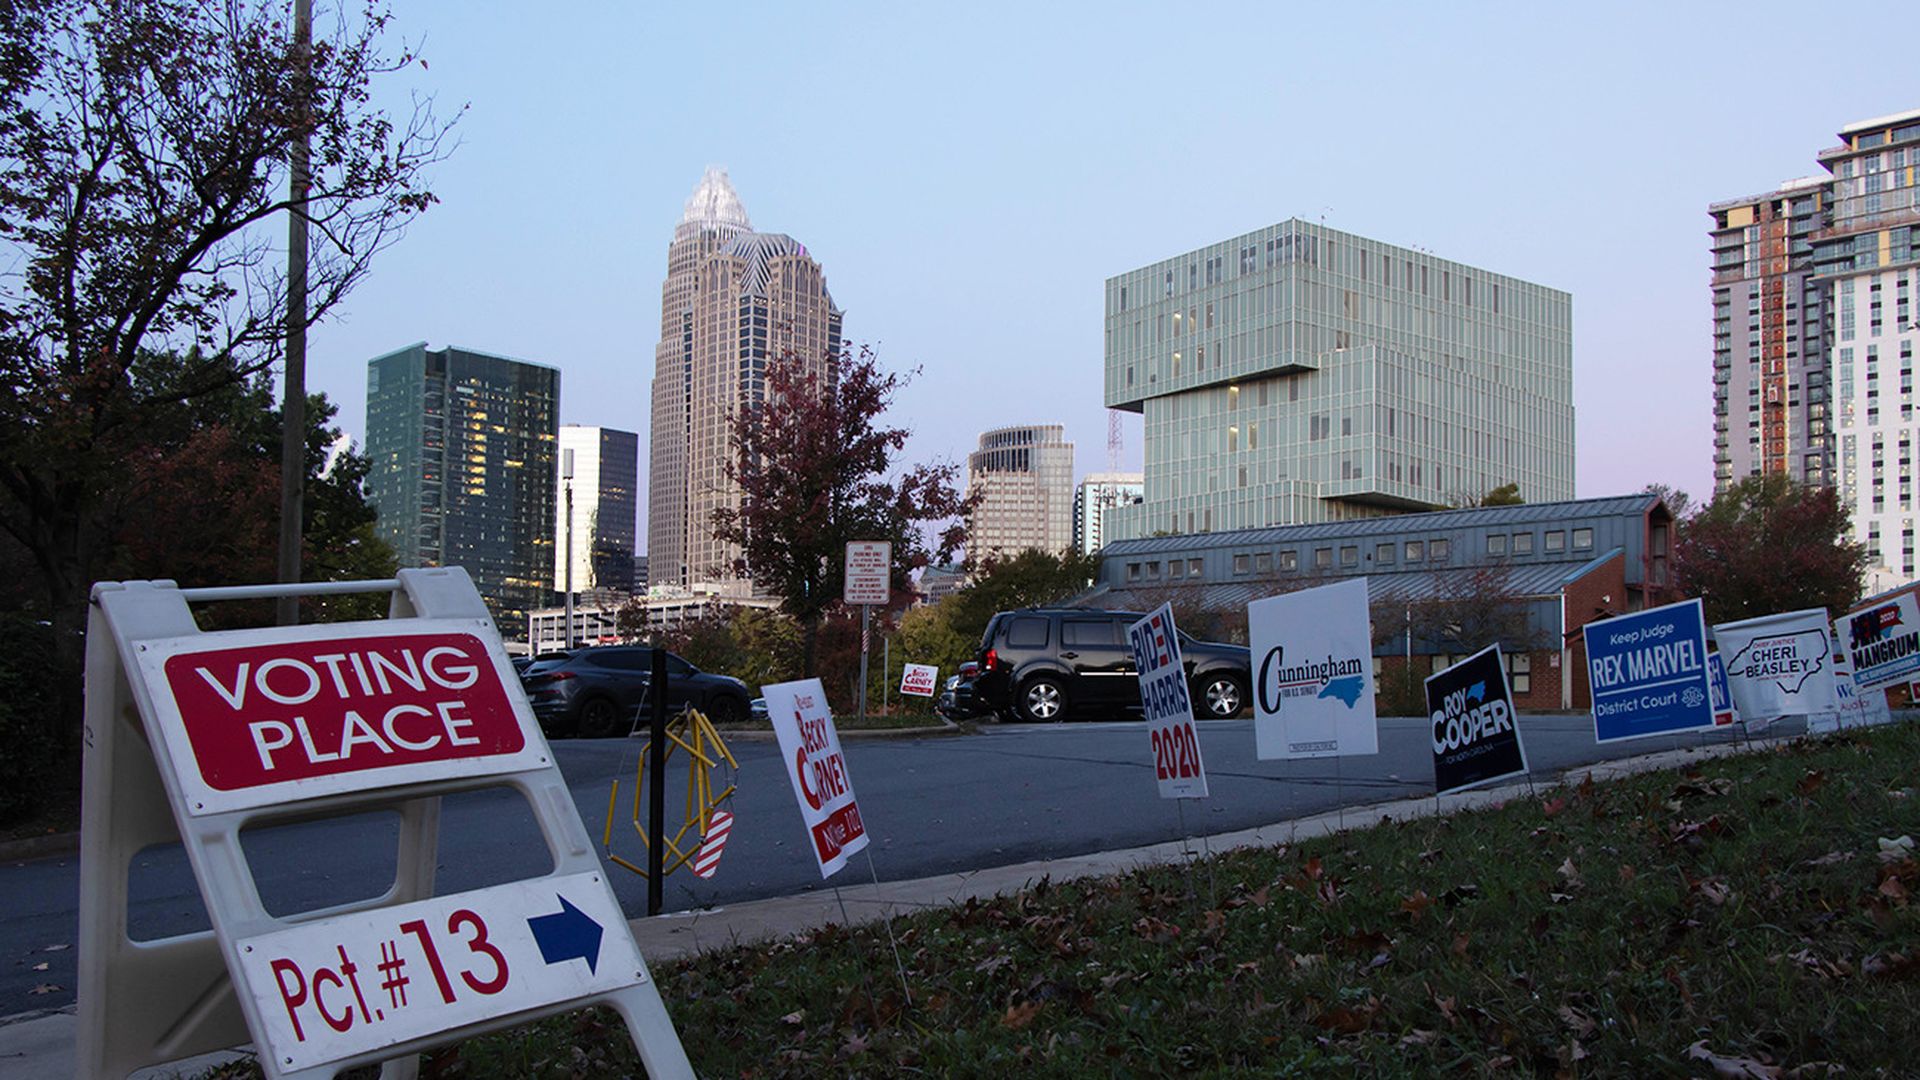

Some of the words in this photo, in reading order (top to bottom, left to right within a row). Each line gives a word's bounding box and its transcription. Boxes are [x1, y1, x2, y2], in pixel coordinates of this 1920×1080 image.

[1131, 609, 1179, 676] BIDEN
[1610, 631, 1639, 646] Keep
[1640, 623, 1675, 642] Judge
[1752, 646, 1796, 663] CHERI
[1850, 609, 1882, 651] JEN
[1851, 631, 1920, 672] MANGRUM
[195, 646, 479, 711] VOTING
[1258, 645, 1363, 714] Cunningham
[1592, 653, 1626, 689] REX
[1627, 639, 1702, 682] MARVEL
[1745, 659, 1809, 678] BEASLEY
[1142, 670, 1189, 721] HARRIS
[1443, 687, 1466, 719] ROY
[1597, 699, 1639, 717] District
[1640, 692, 1677, 708] Court
[248, 700, 481, 770] PLACE
[794, 710, 830, 754] BECKY
[1152, 723, 1200, 780] 2020
[1431, 699, 1512, 755] COOPER
[796, 746, 850, 811] CRNEY
